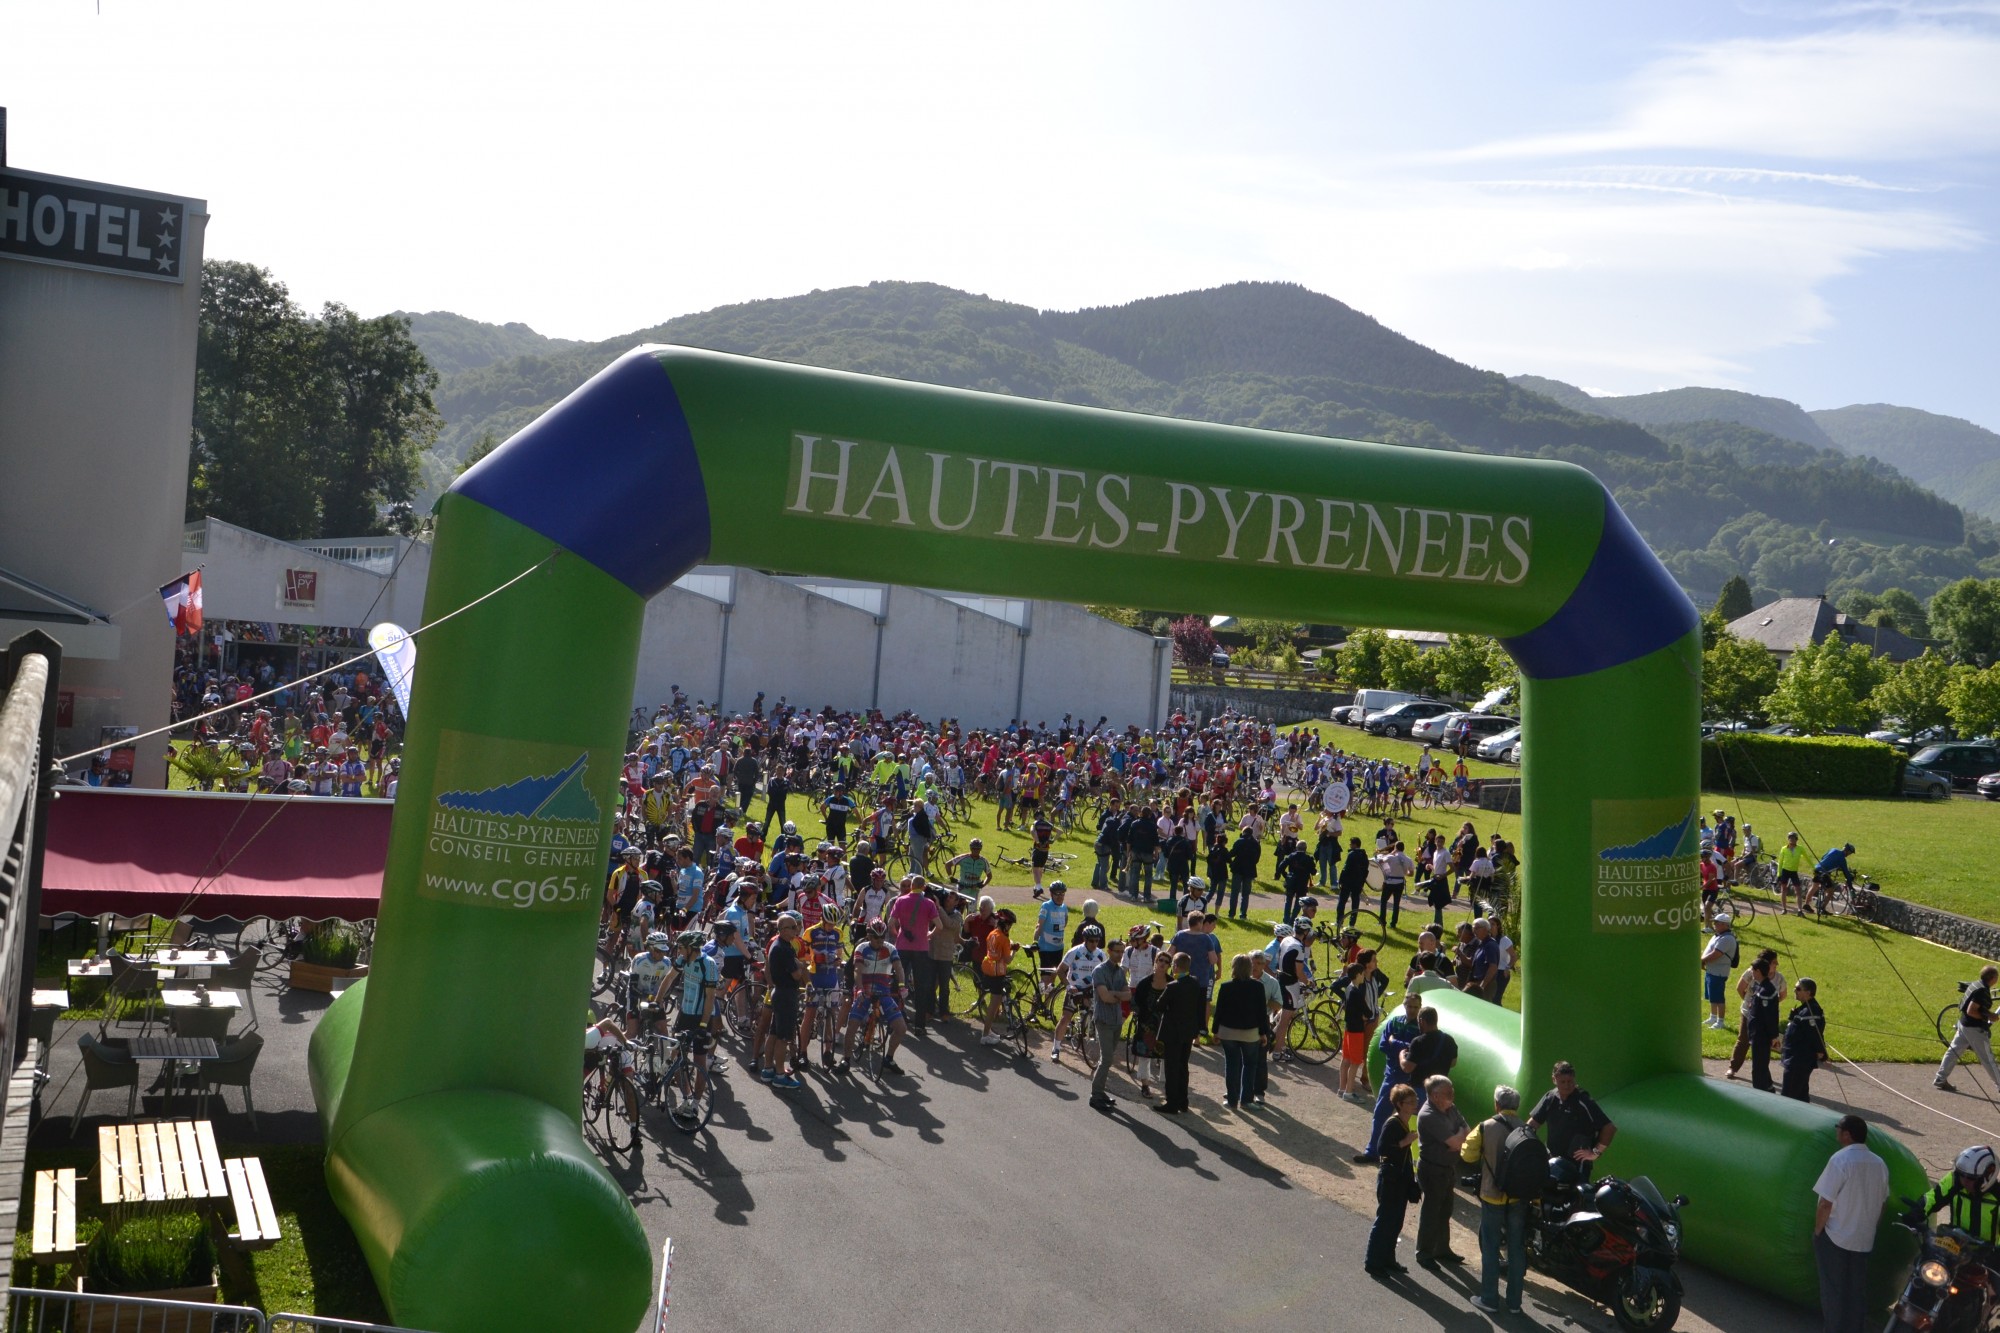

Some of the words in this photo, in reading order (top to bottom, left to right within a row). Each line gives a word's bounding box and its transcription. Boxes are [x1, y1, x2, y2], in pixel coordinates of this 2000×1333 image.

[0, 188, 151, 261] HOTEL
[786, 432, 1531, 586] HAUTES-PYRENEES
[433, 812, 600, 845] HAUTES-PYRENEES
[429, 836, 511, 863] CONSEIL
[524, 850, 596, 867] GENERAL
[425, 873, 592, 909] www.cg65.fr
[1597, 884, 1664, 897] CONSEIL
